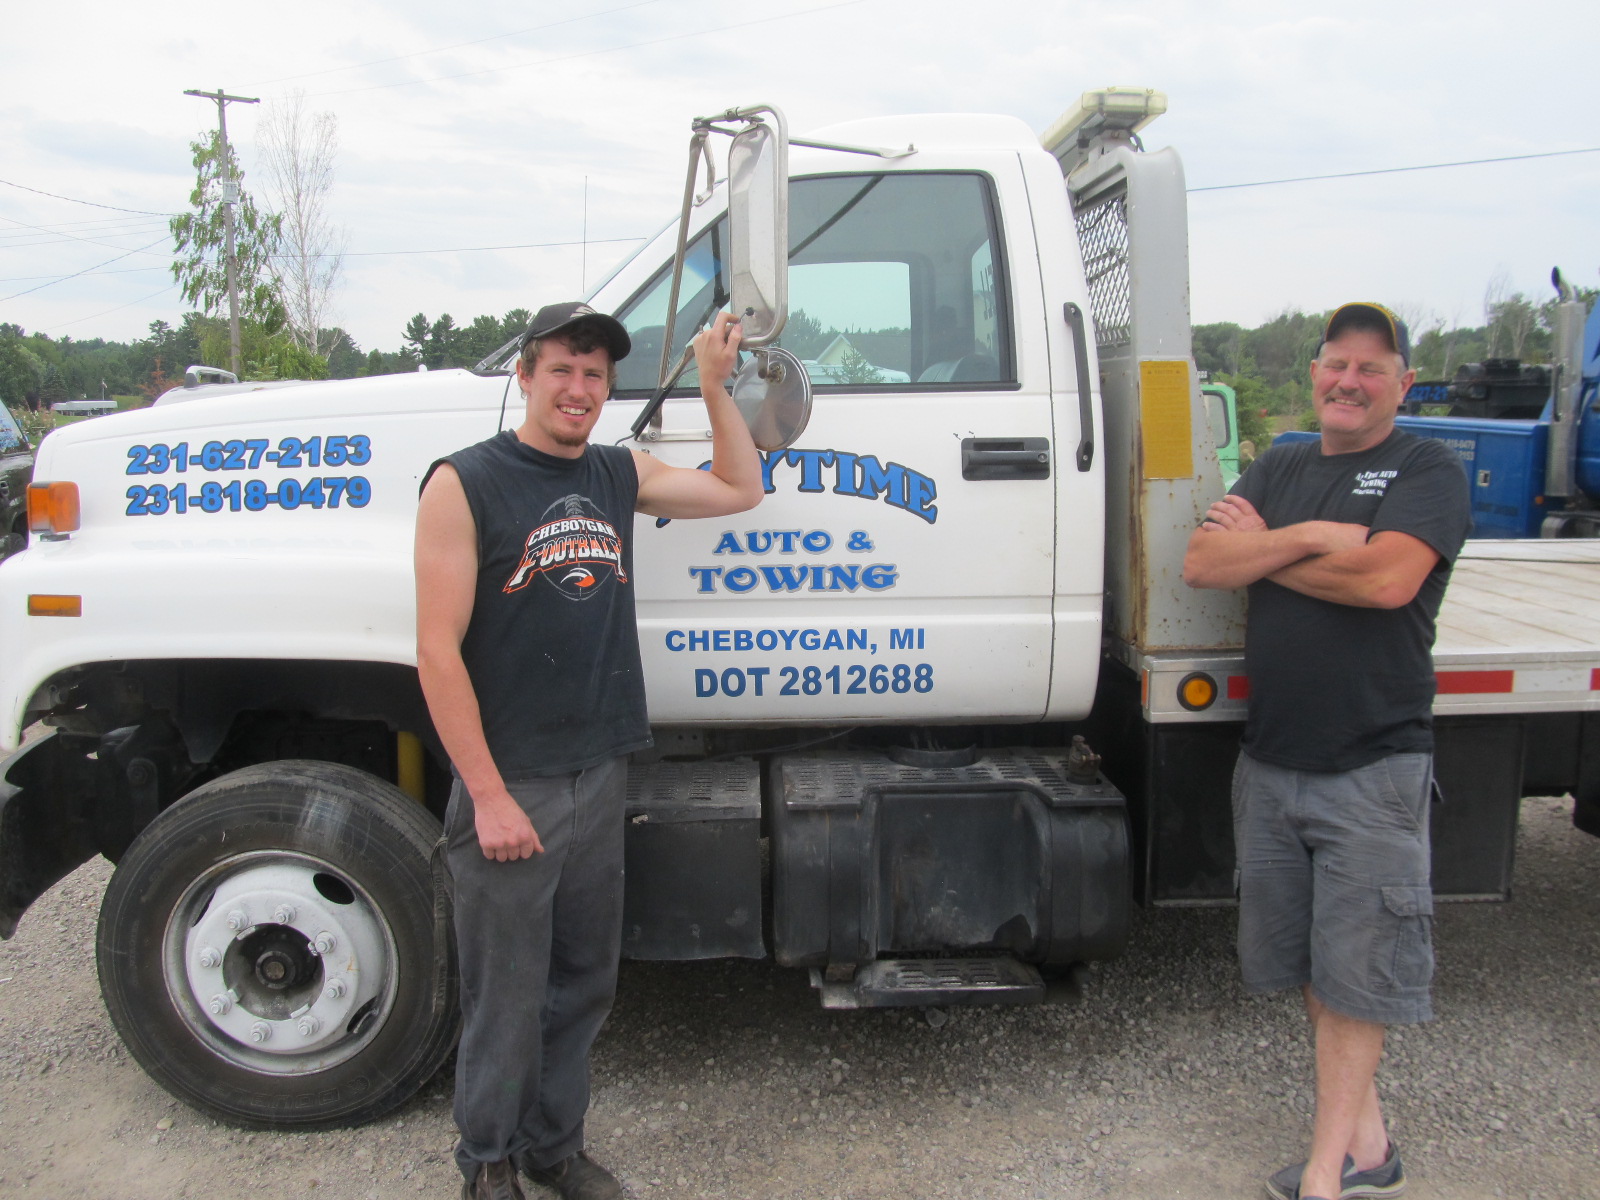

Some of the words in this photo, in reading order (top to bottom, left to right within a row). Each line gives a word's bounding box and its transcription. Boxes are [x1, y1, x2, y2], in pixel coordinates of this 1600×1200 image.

[126, 435, 371, 475] 231-627-2153
[126, 476, 371, 516] 231-818-0479
[655, 448, 938, 527] YTIME
[528, 519, 616, 547] CHEBOYGAN
[712, 529, 834, 556] AUTO
[845, 529, 875, 553] &
[506, 533, 626, 589] FOOTBALL
[688, 563, 900, 594] TOWING
[665, 628, 877, 655] CHEBOYGAN,
[889, 628, 925, 650] MI
[694, 667, 770, 697] DOT
[779, 663, 934, 696] 2812688
